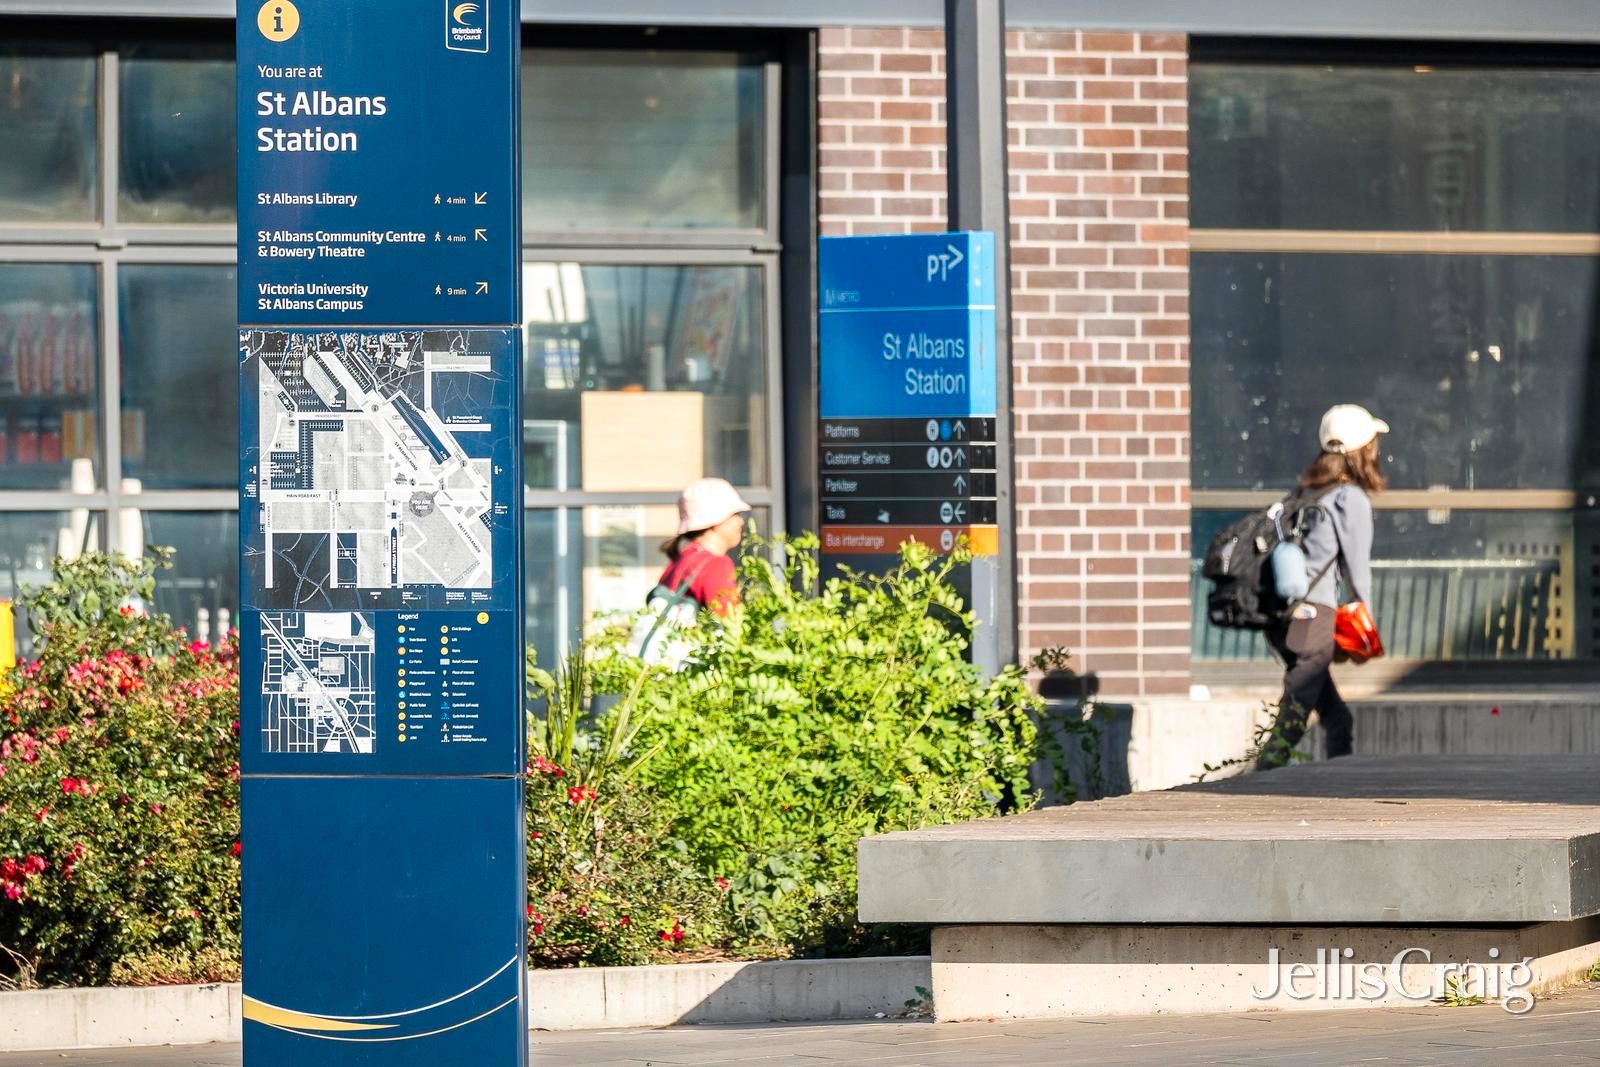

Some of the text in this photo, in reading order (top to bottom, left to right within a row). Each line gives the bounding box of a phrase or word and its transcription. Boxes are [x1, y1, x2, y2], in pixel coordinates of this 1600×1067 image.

[258, 64, 322, 78] You are at
[258, 90, 386, 116] St Albans
[258, 126, 356, 152] Station
[258, 192, 358, 206] St Albans Library
[258, 230, 426, 244] St Albans Community Centre
[258, 246, 366, 260] & Bowery Theatre
[258, 284, 368, 298] Victoria University
[448, 288, 452, 296] 9
[258, 298, 364, 312] St Albans Campus
[884, 333, 965, 359] St Albans
[906, 368, 964, 395] Station
[825, 424, 860, 438] Platforms
[825, 451, 891, 465] Customer Service
[826, 505, 846, 520] Taxis
[826, 533, 842, 547] Bus
